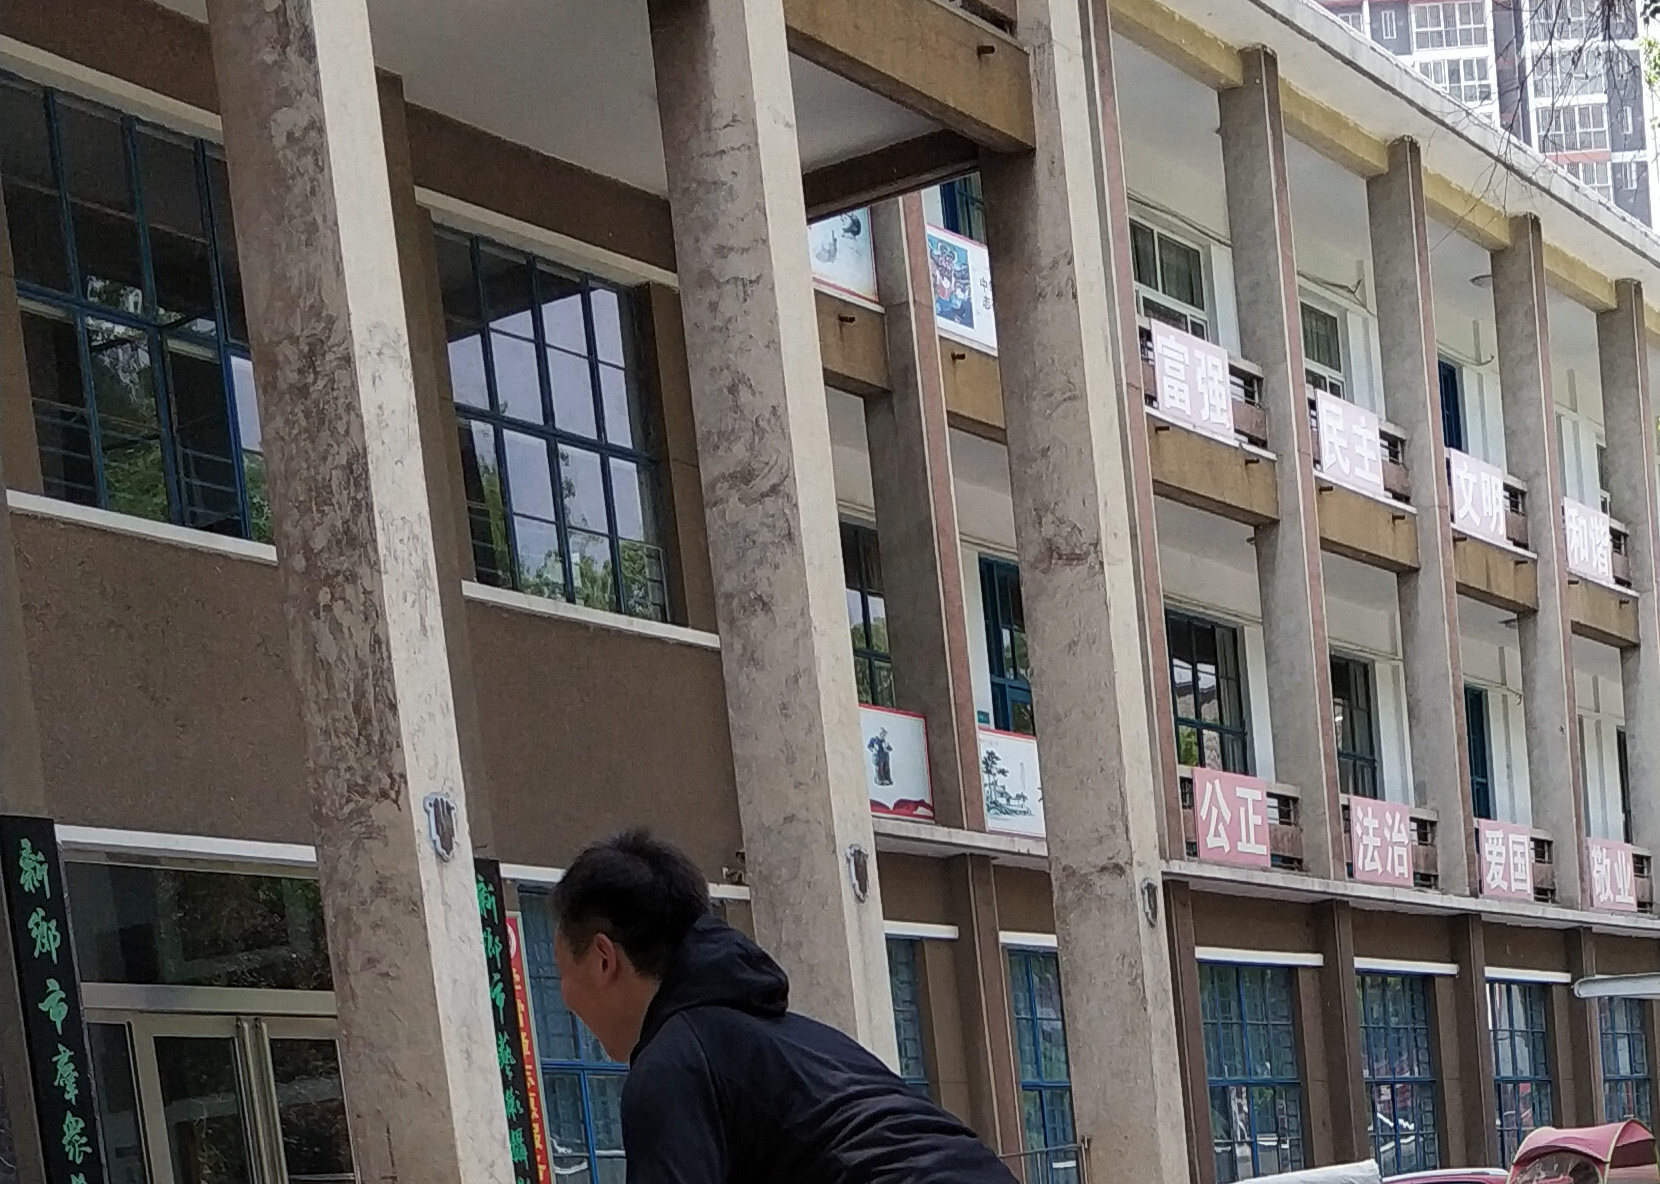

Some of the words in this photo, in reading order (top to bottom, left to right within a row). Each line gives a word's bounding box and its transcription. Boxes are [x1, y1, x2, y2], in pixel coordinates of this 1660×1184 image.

[1156, 333, 1231, 430] 富强
[1321, 402, 1383, 486] 民主
[1453, 459, 1505, 535] 文明
[1567, 508, 1609, 577] 和谐
[1200, 778, 1267, 855] 公正
[1356, 806, 1408, 878] 法治
[1485, 829, 1532, 893] 爱国
[1592, 845, 1635, 904] 敬业
